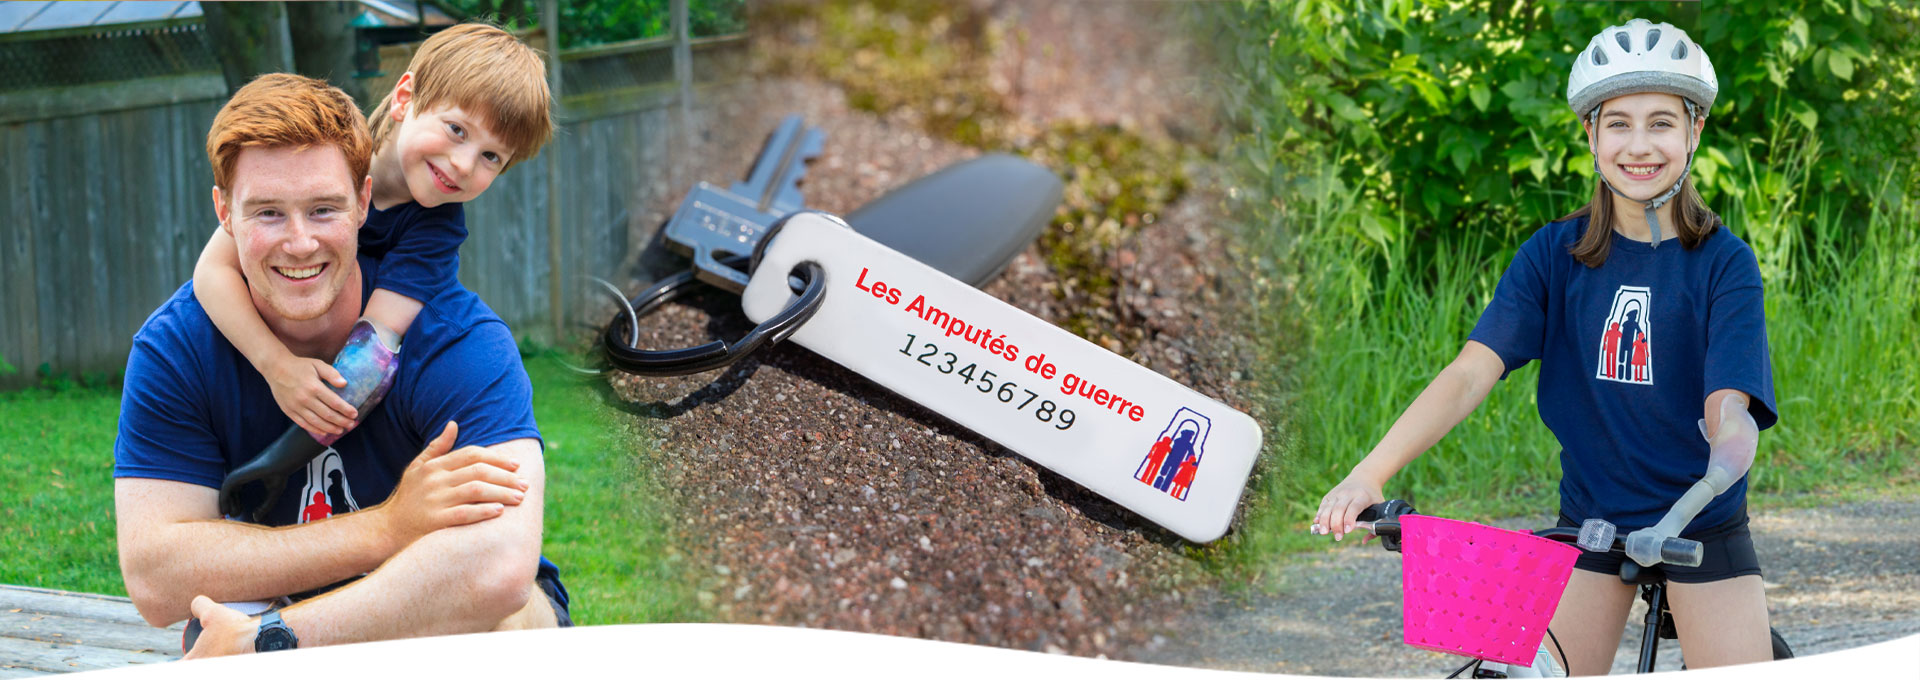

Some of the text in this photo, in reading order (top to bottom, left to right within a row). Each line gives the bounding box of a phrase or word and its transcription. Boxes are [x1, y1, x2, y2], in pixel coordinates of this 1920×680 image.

[855, 266, 1145, 422] Les Amputés de guerre
[898, 333, 1077, 431] 123456789
